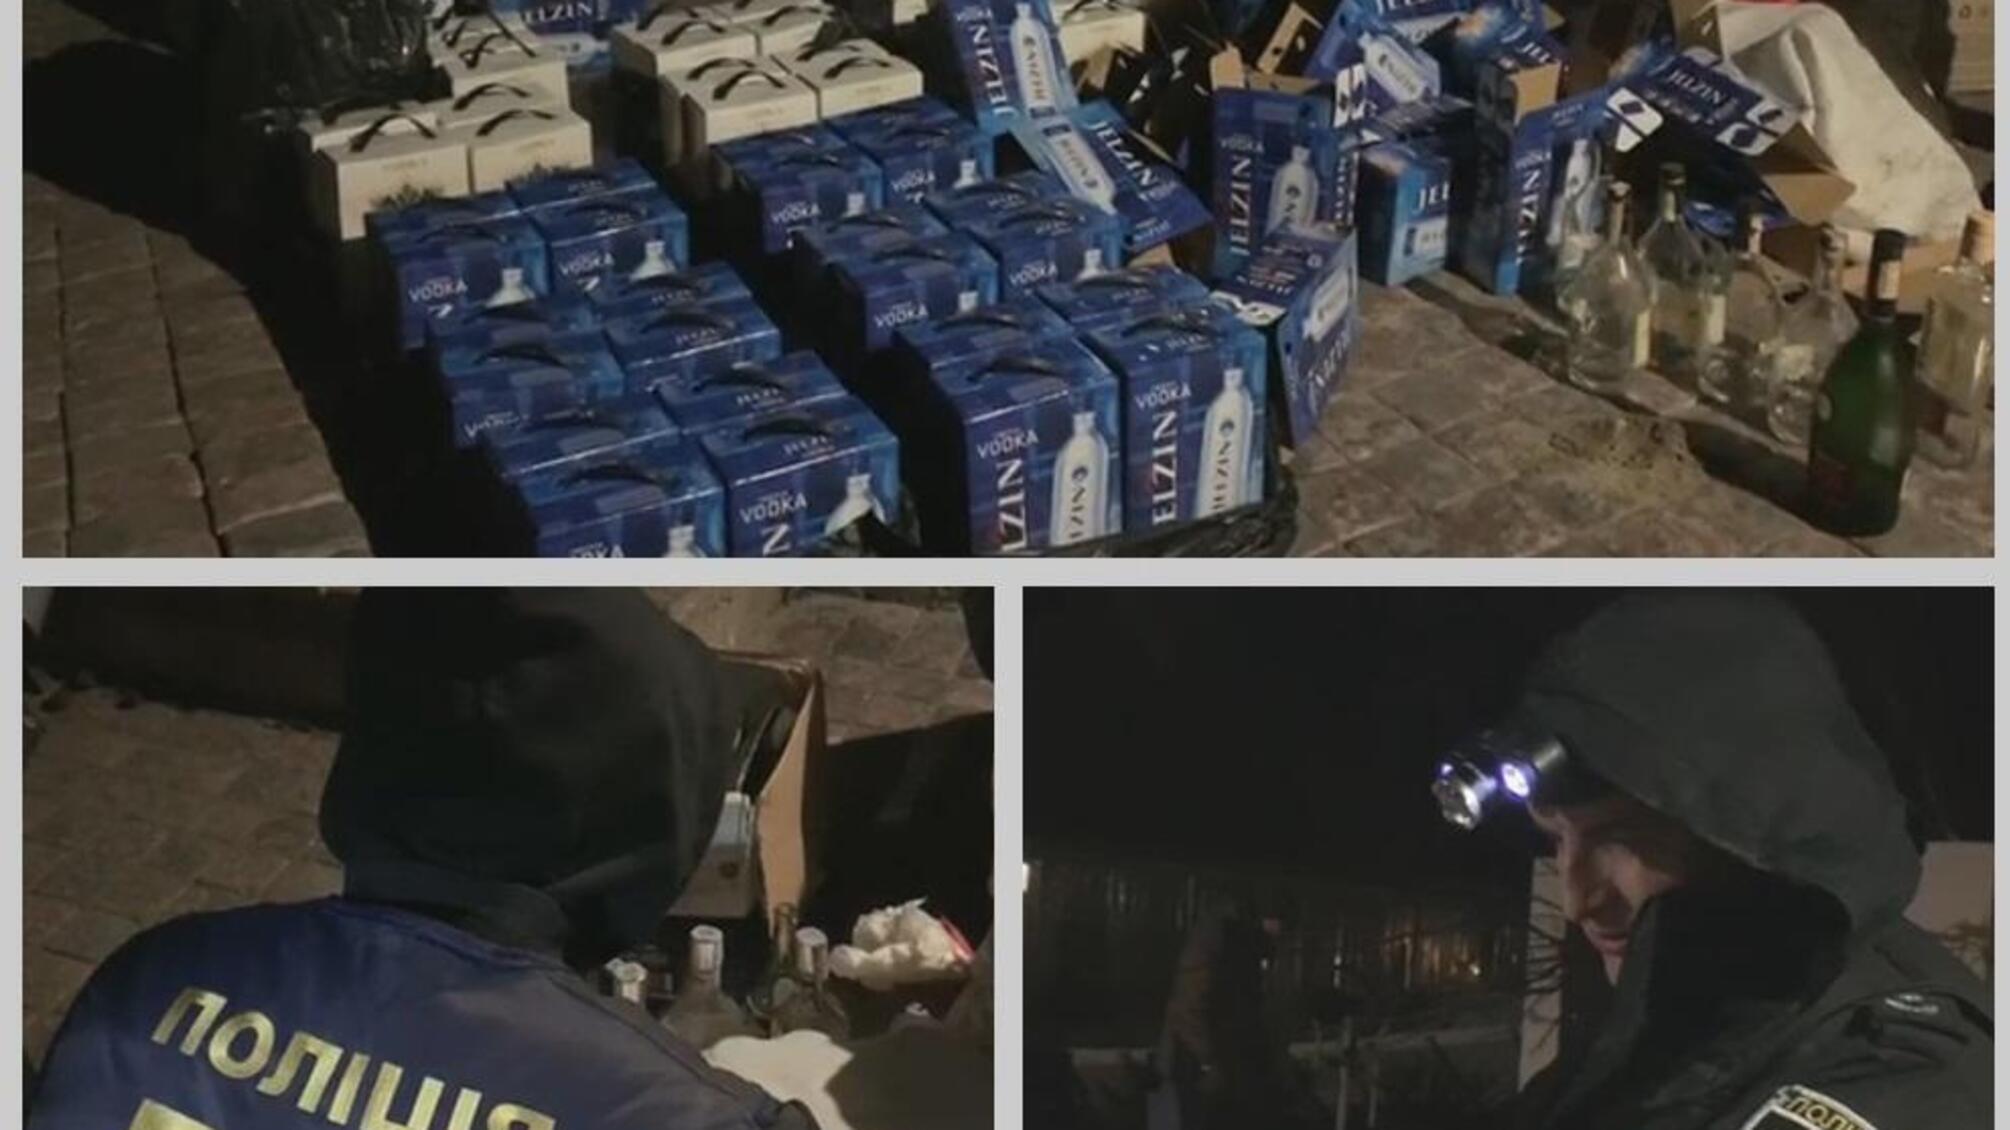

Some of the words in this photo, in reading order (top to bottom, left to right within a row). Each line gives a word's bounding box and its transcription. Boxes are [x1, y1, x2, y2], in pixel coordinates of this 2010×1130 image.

[968, 24, 1018, 116] JELZIN
[1665, 68, 1728, 105] JELZIN
[1083, 119, 1153, 188] JELZIN
[772, 202, 821, 224] VODKA
[1231, 154, 1251, 256] JELZIN
[1411, 181, 1450, 216] JEL
[559, 252, 615, 276] VODKA
[1009, 261, 1059, 286] VODKA
[409, 278, 469, 303] VODKA
[873, 303, 929, 328] VODKA
[1132, 382, 1192, 411] VODKA
[976, 428, 1039, 459] VODKA
[1151, 411, 1177, 526] ELZIN
[740, 492, 808, 524] VODKA
[996, 458, 1028, 552] LZIN
